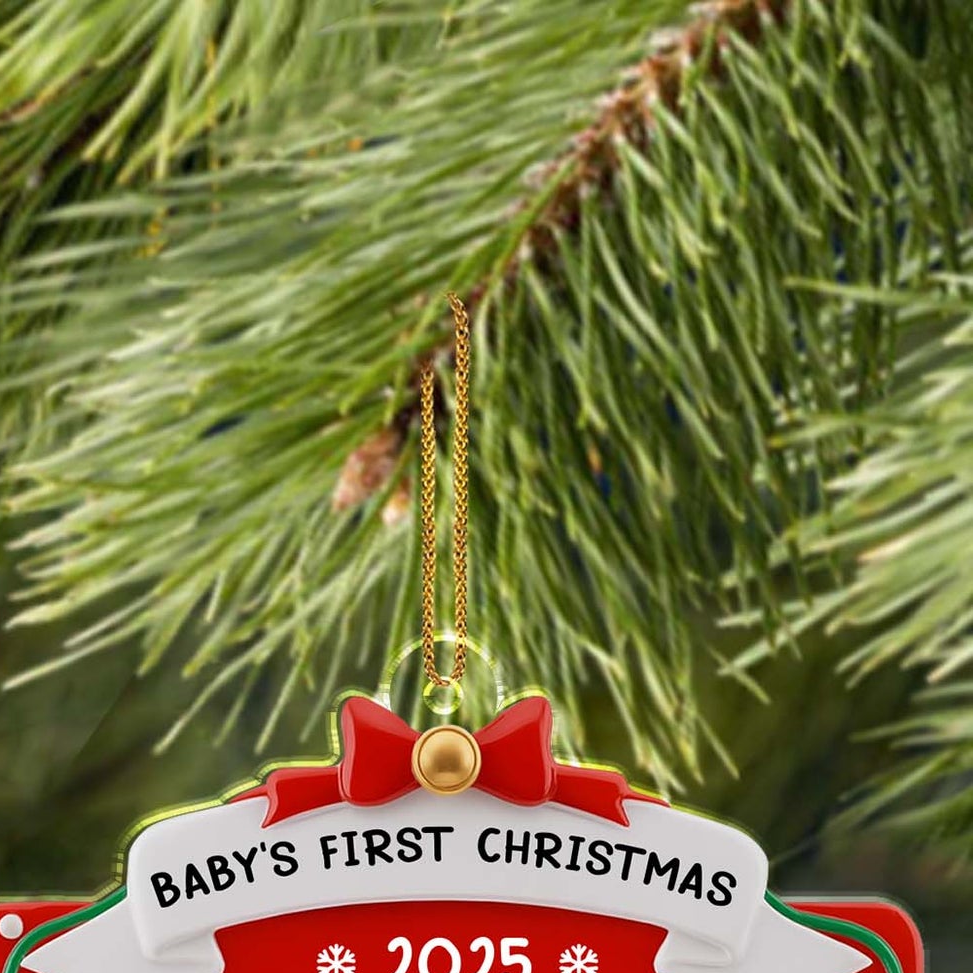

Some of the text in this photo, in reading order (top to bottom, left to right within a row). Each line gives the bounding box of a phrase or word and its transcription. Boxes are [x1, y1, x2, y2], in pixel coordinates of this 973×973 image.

[150, 826, 737, 909] BABY'S FIRST CHRISTMAS
